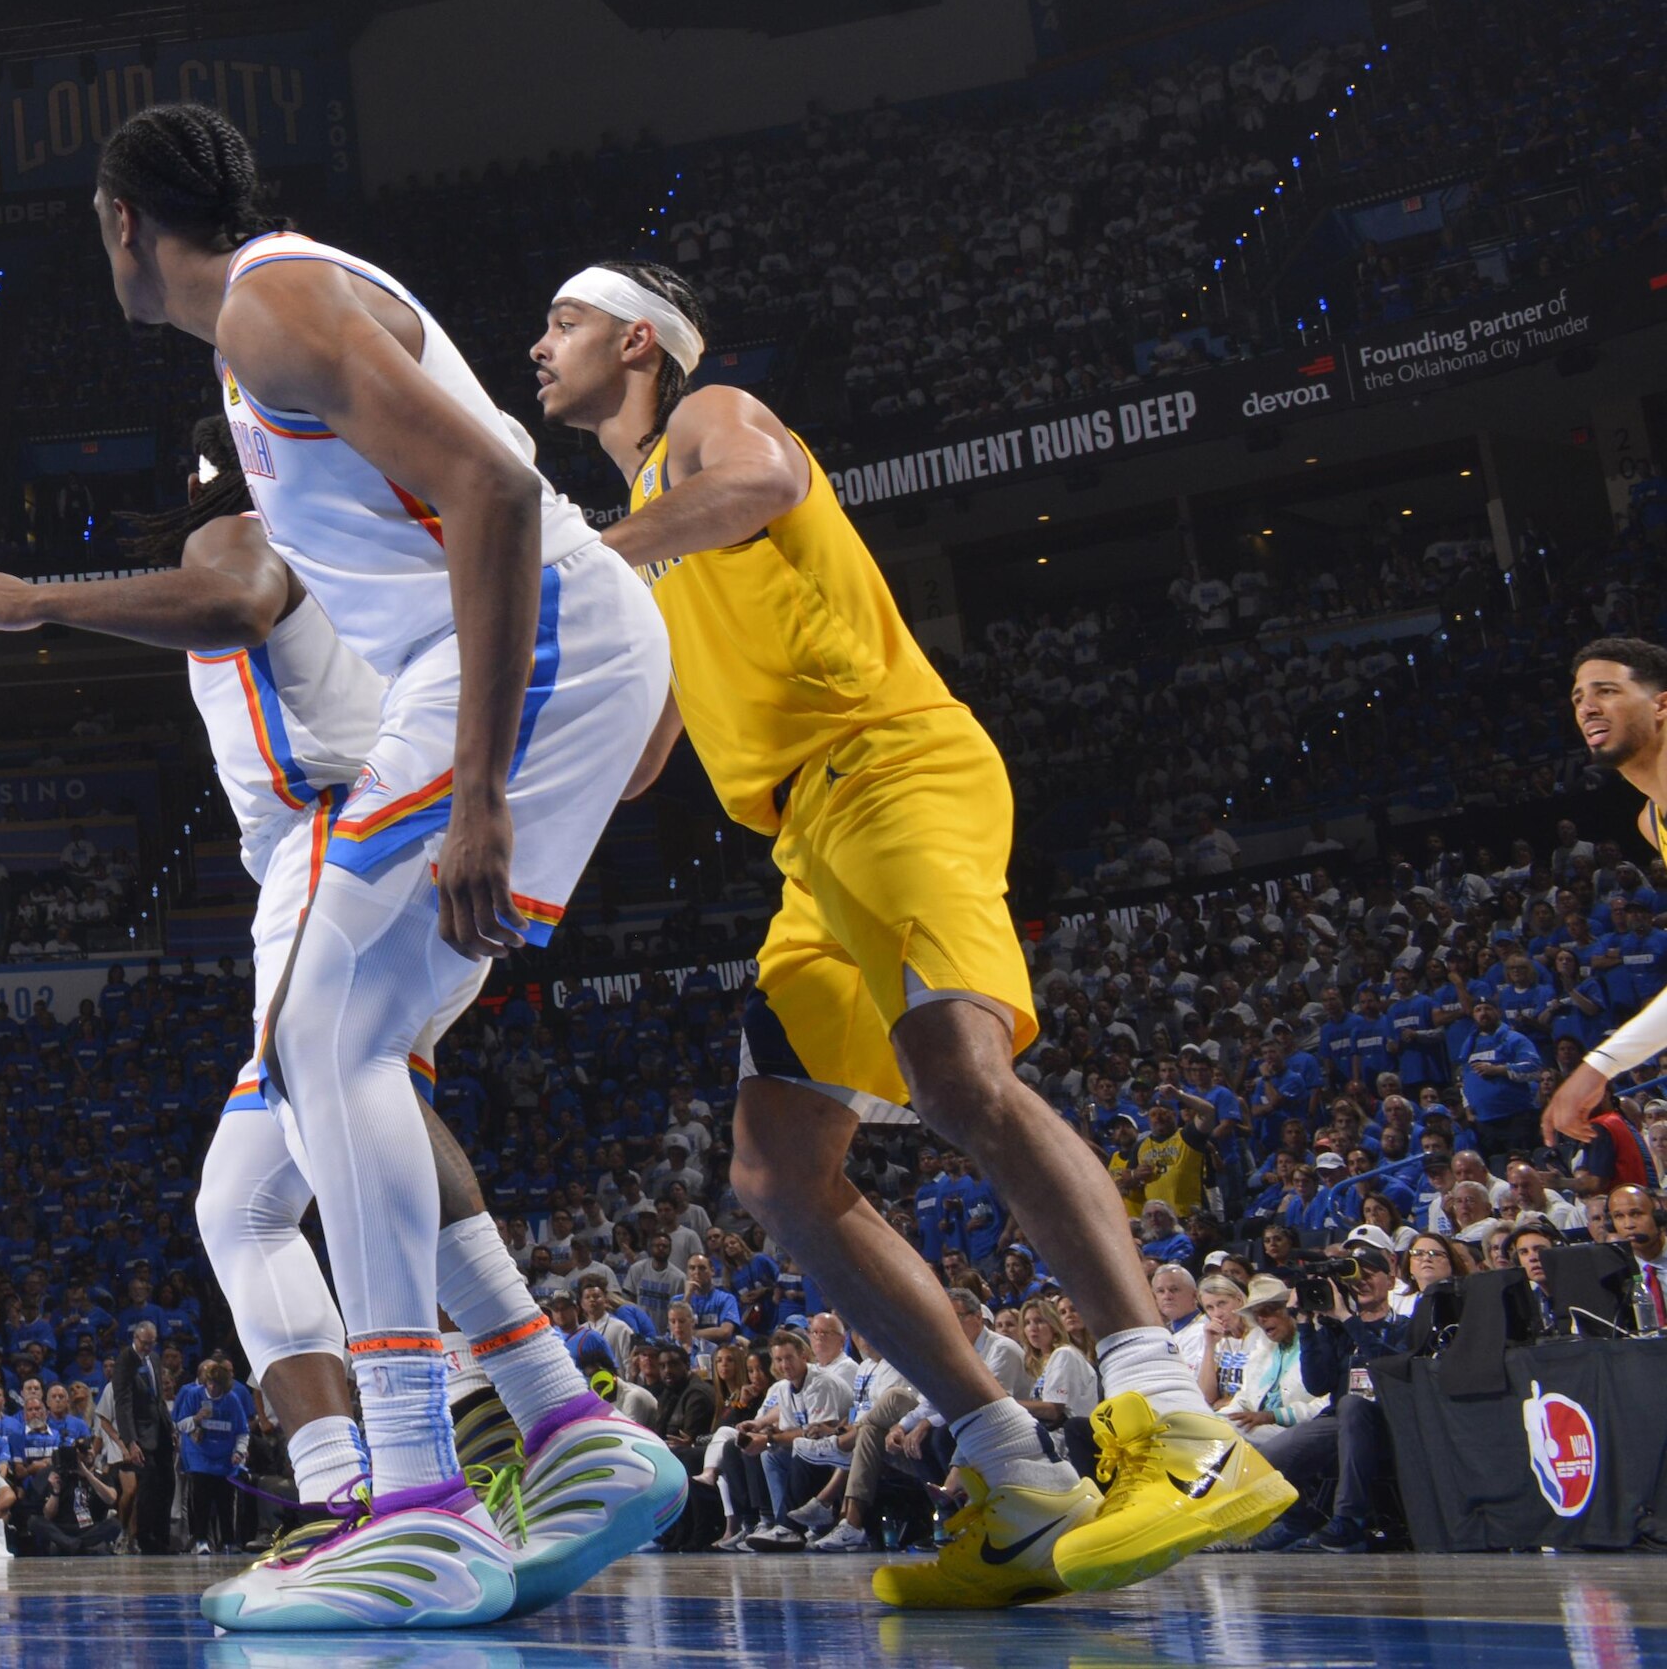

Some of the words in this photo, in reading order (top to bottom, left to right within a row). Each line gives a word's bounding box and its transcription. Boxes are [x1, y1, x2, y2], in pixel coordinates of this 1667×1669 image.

[1359, 328, 1468, 368] Founding
[1471, 303, 1546, 343] Partner
[1397, 347, 1489, 384] Oklahoma
[1523, 314, 1591, 347] Thunder
[1241, 382, 1331, 418] devon
[828, 427, 1023, 509] COMMITMENT
[1030, 409, 1115, 466] RUNS
[1118, 390, 1198, 445] DEEP
[1554, 1460, 1592, 1480] ESPN
